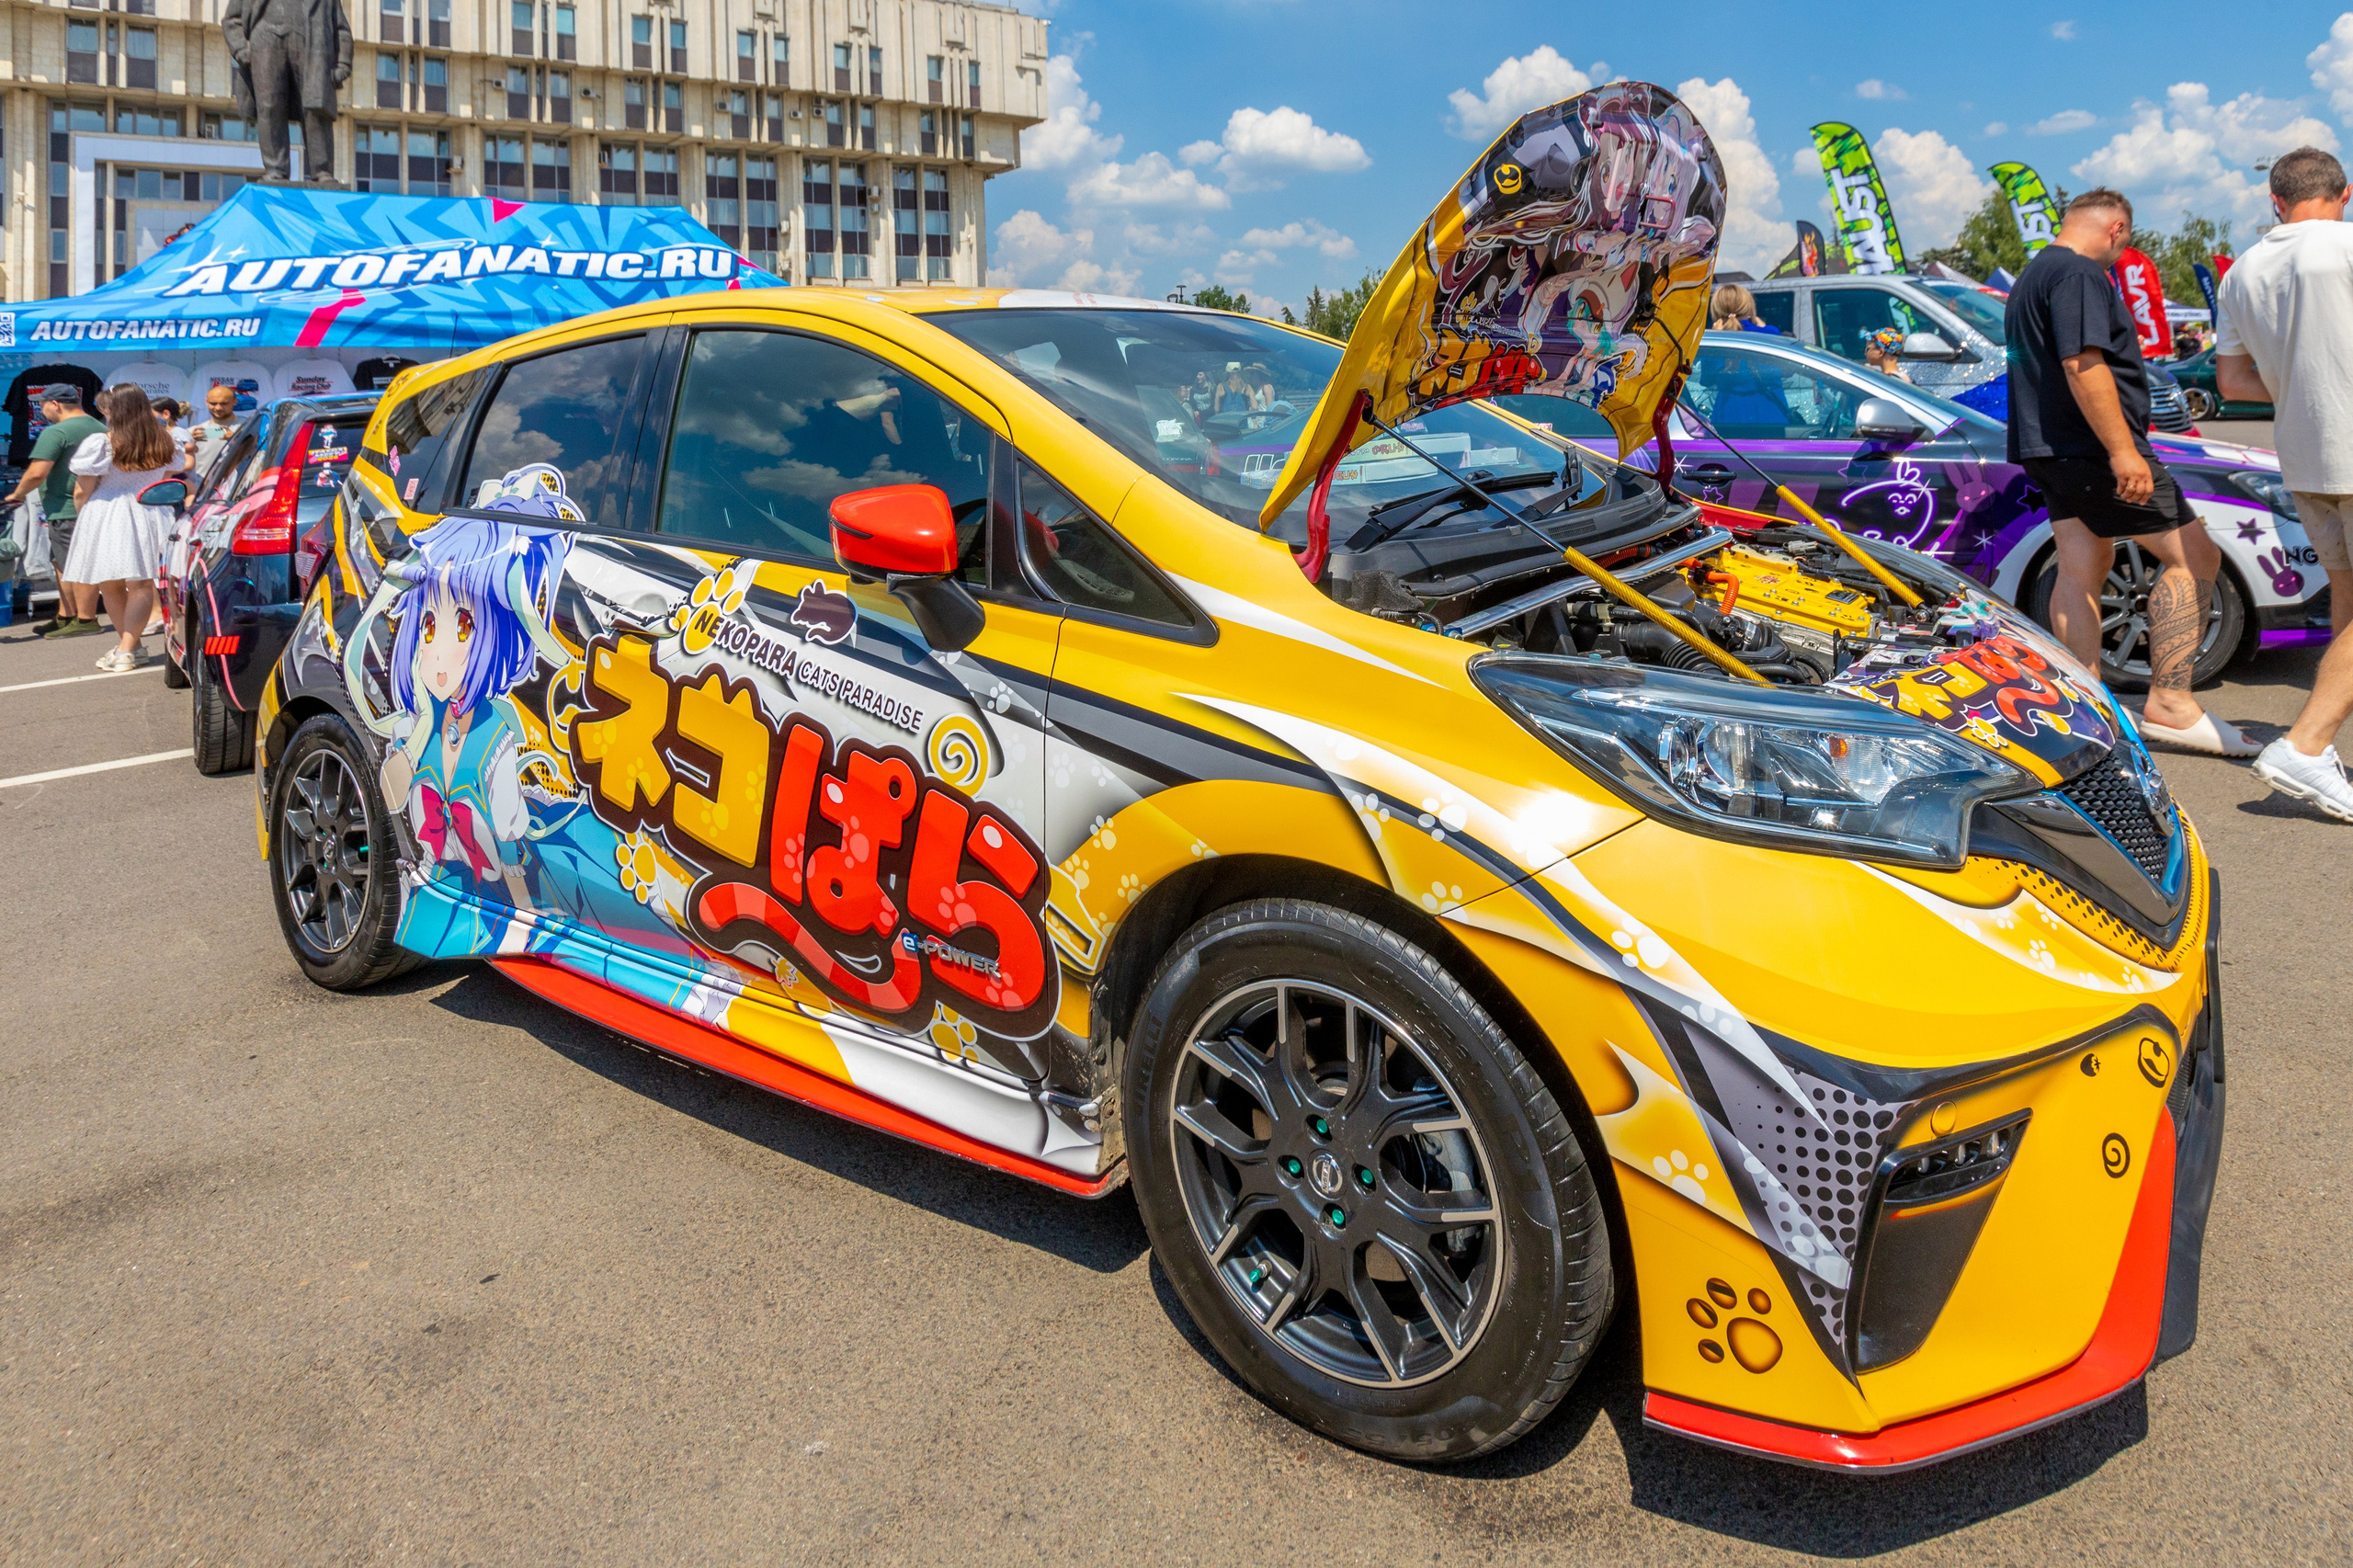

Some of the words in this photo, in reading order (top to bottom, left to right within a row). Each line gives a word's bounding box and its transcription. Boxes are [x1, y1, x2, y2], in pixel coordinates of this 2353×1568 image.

[163, 244, 736, 297] AUTOFANATIC.RU
[29, 317, 262, 341] AUTOFANATIC.RU
[2124, 263, 2160, 346] LAVR
[131, 381, 170, 390] orsche
[296, 376, 326, 384] Sunday
[694, 609, 798, 678] NEKOPARA
[800, 661, 840, 693] CATS
[842, 679, 925, 732] PARADISE
[576, 632, 1047, 1012] ネコぱら
[902, 932, 1002, 978] e-POWER
